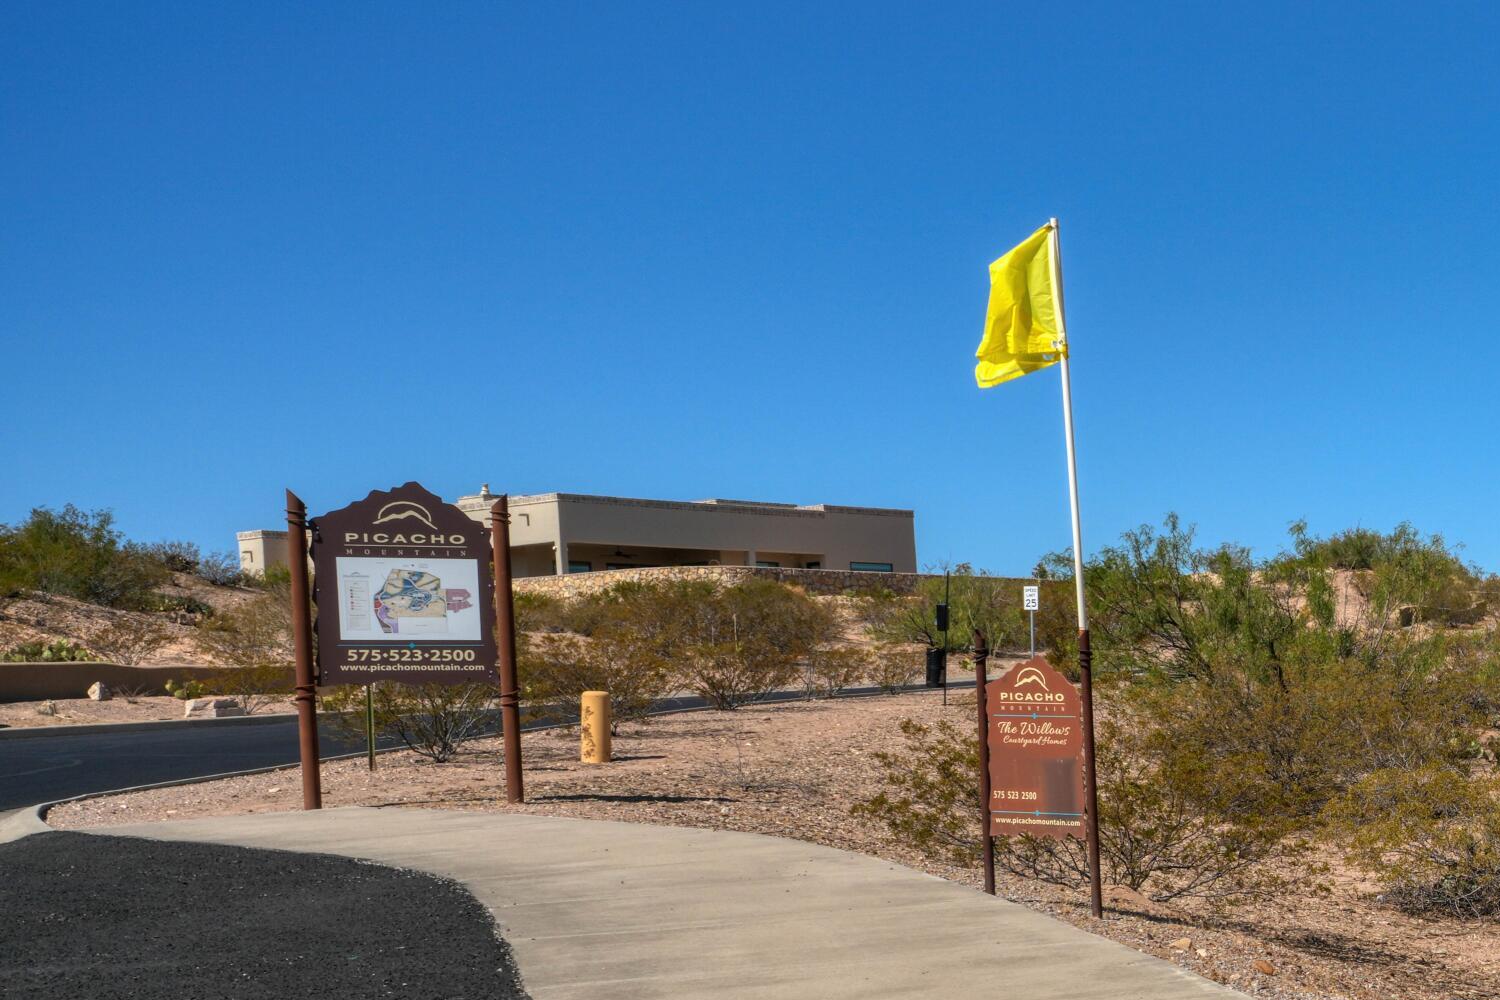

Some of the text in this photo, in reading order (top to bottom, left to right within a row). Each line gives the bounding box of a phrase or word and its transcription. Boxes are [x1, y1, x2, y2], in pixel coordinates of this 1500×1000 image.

[344, 533, 466, 544] PICACHO
[345, 548, 466, 556] MOUNTAIN
[1026, 599, 1037, 607] 25
[340, 663, 485, 672] www.picachomountain.com
[1000, 692, 1065, 702] PICACHO
[997, 721, 1071, 736] The Willows
[1003, 735, 1068, 748] Courtyard Homes
[993, 790, 1037, 800] 575 523 2500
[995, 817, 1081, 827] www.picachomountain.com
